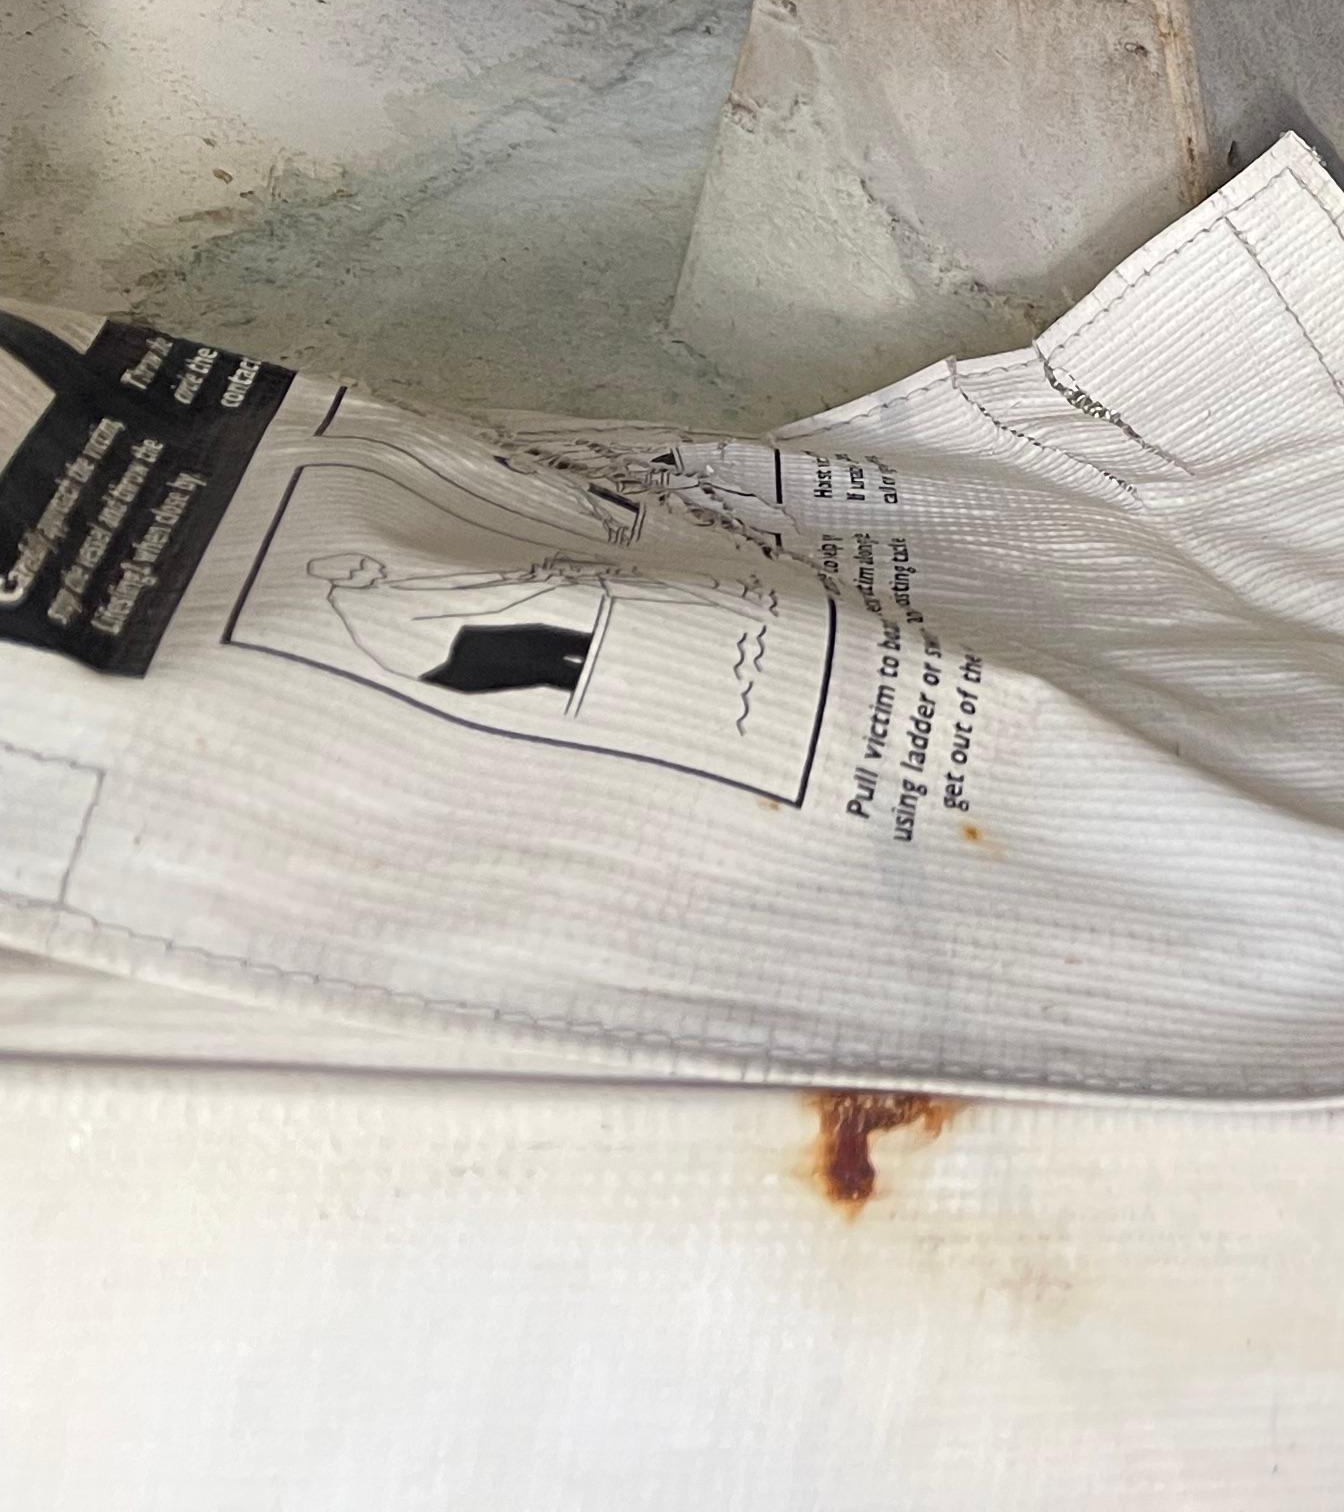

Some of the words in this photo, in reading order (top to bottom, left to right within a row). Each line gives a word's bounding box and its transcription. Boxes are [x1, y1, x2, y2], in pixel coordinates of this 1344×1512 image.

[185, 347, 218, 374] the
[131, 439, 164, 463] the
[64, 455, 95, 484] the
[151, 491, 190, 525] close
[877, 655, 900, 678] to
[922, 661, 942, 687] or
[959, 654, 982, 684] the
[956, 686, 979, 715] of
[862, 684, 896, 760] victim
[900, 691, 937, 773] ladder
[951, 721, 974, 765] out
[846, 767, 879, 819] Pull
[943, 771, 970, 812] get
[891, 778, 928, 842] using
